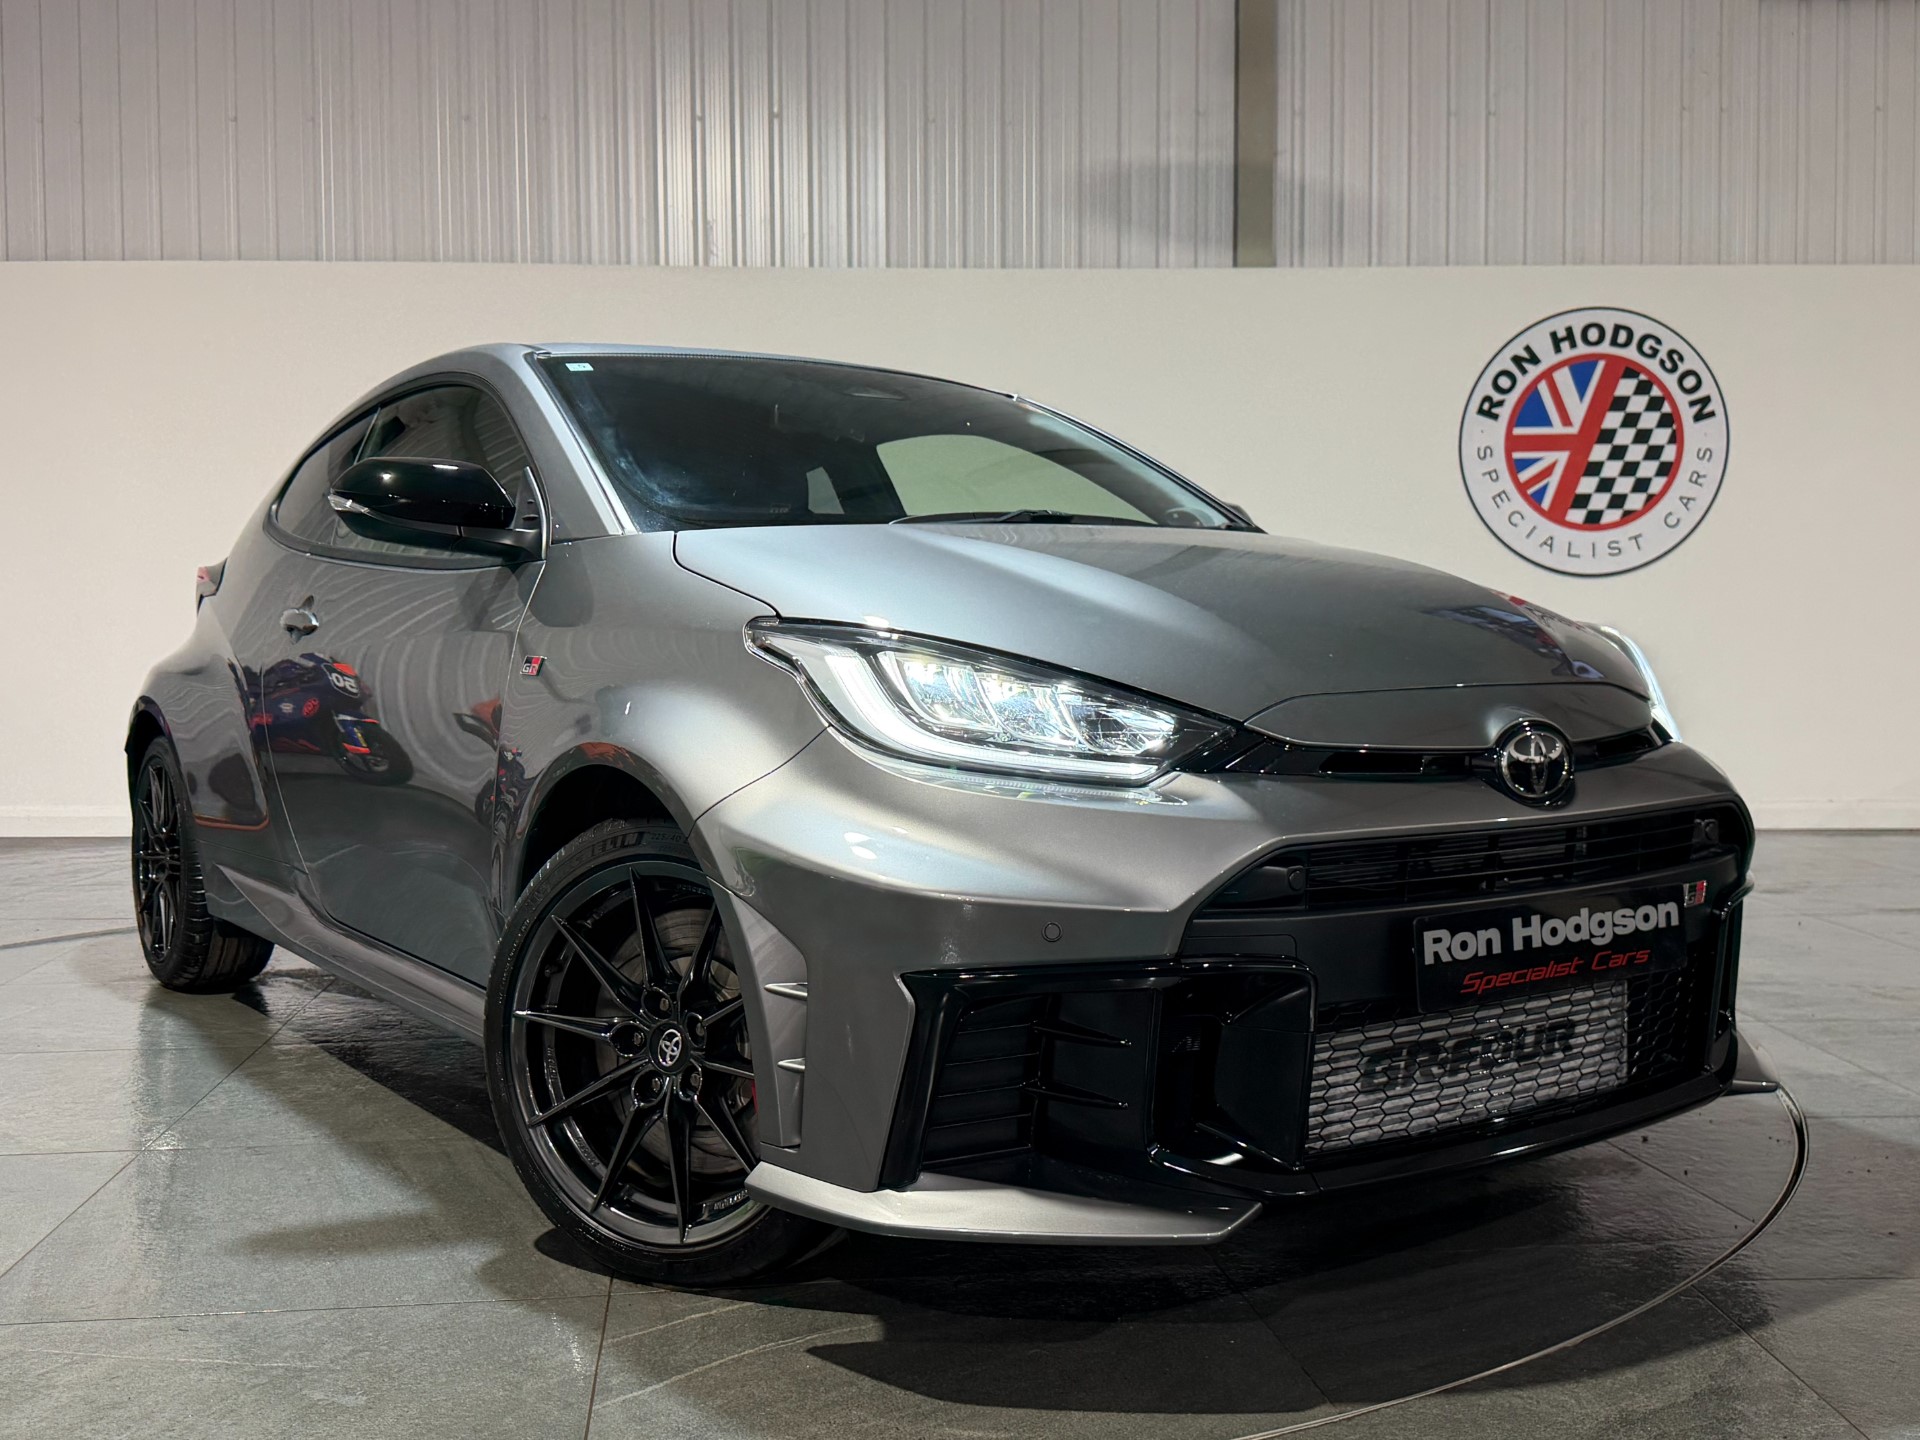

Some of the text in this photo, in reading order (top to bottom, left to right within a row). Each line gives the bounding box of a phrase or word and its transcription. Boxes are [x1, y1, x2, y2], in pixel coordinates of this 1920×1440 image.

[1476, 322, 1716, 425] RON HODGSON
[1476, 445, 1714, 559] SPECIALIST CARS
[1423, 901, 1680, 966] Ron Hodgson
[1460, 949, 1651, 995] Specialist Cars
